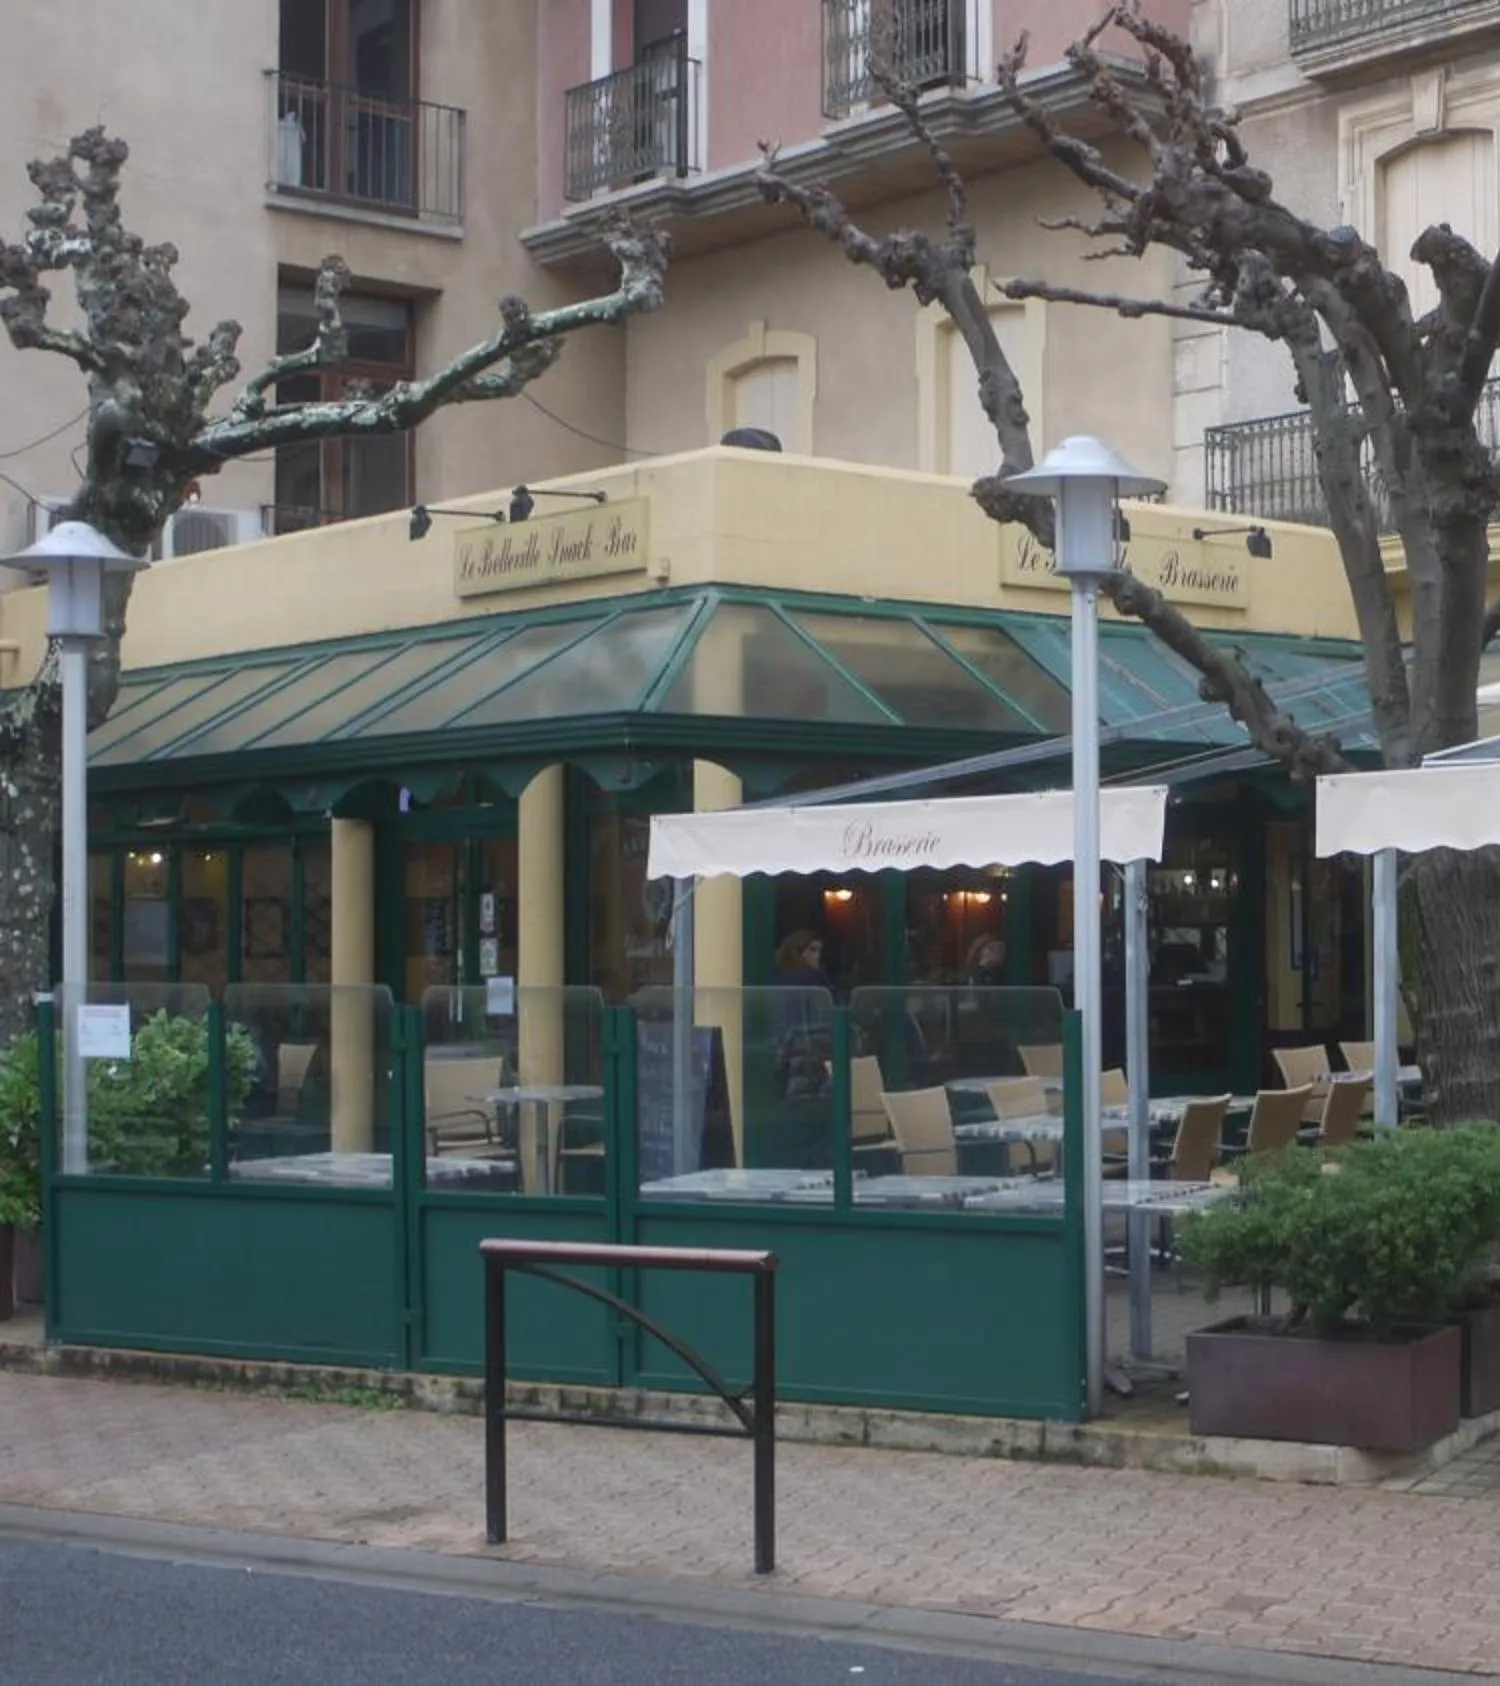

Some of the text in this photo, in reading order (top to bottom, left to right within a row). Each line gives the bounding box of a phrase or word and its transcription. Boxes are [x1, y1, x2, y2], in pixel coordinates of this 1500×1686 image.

[459, 543, 475, 579] Le
[477, 530, 541, 577] Belleville
[1016, 535, 1042, 572] Le
[1158, 552, 1240, 593] Brasserie
[842, 819, 941, 857] Brasserie
